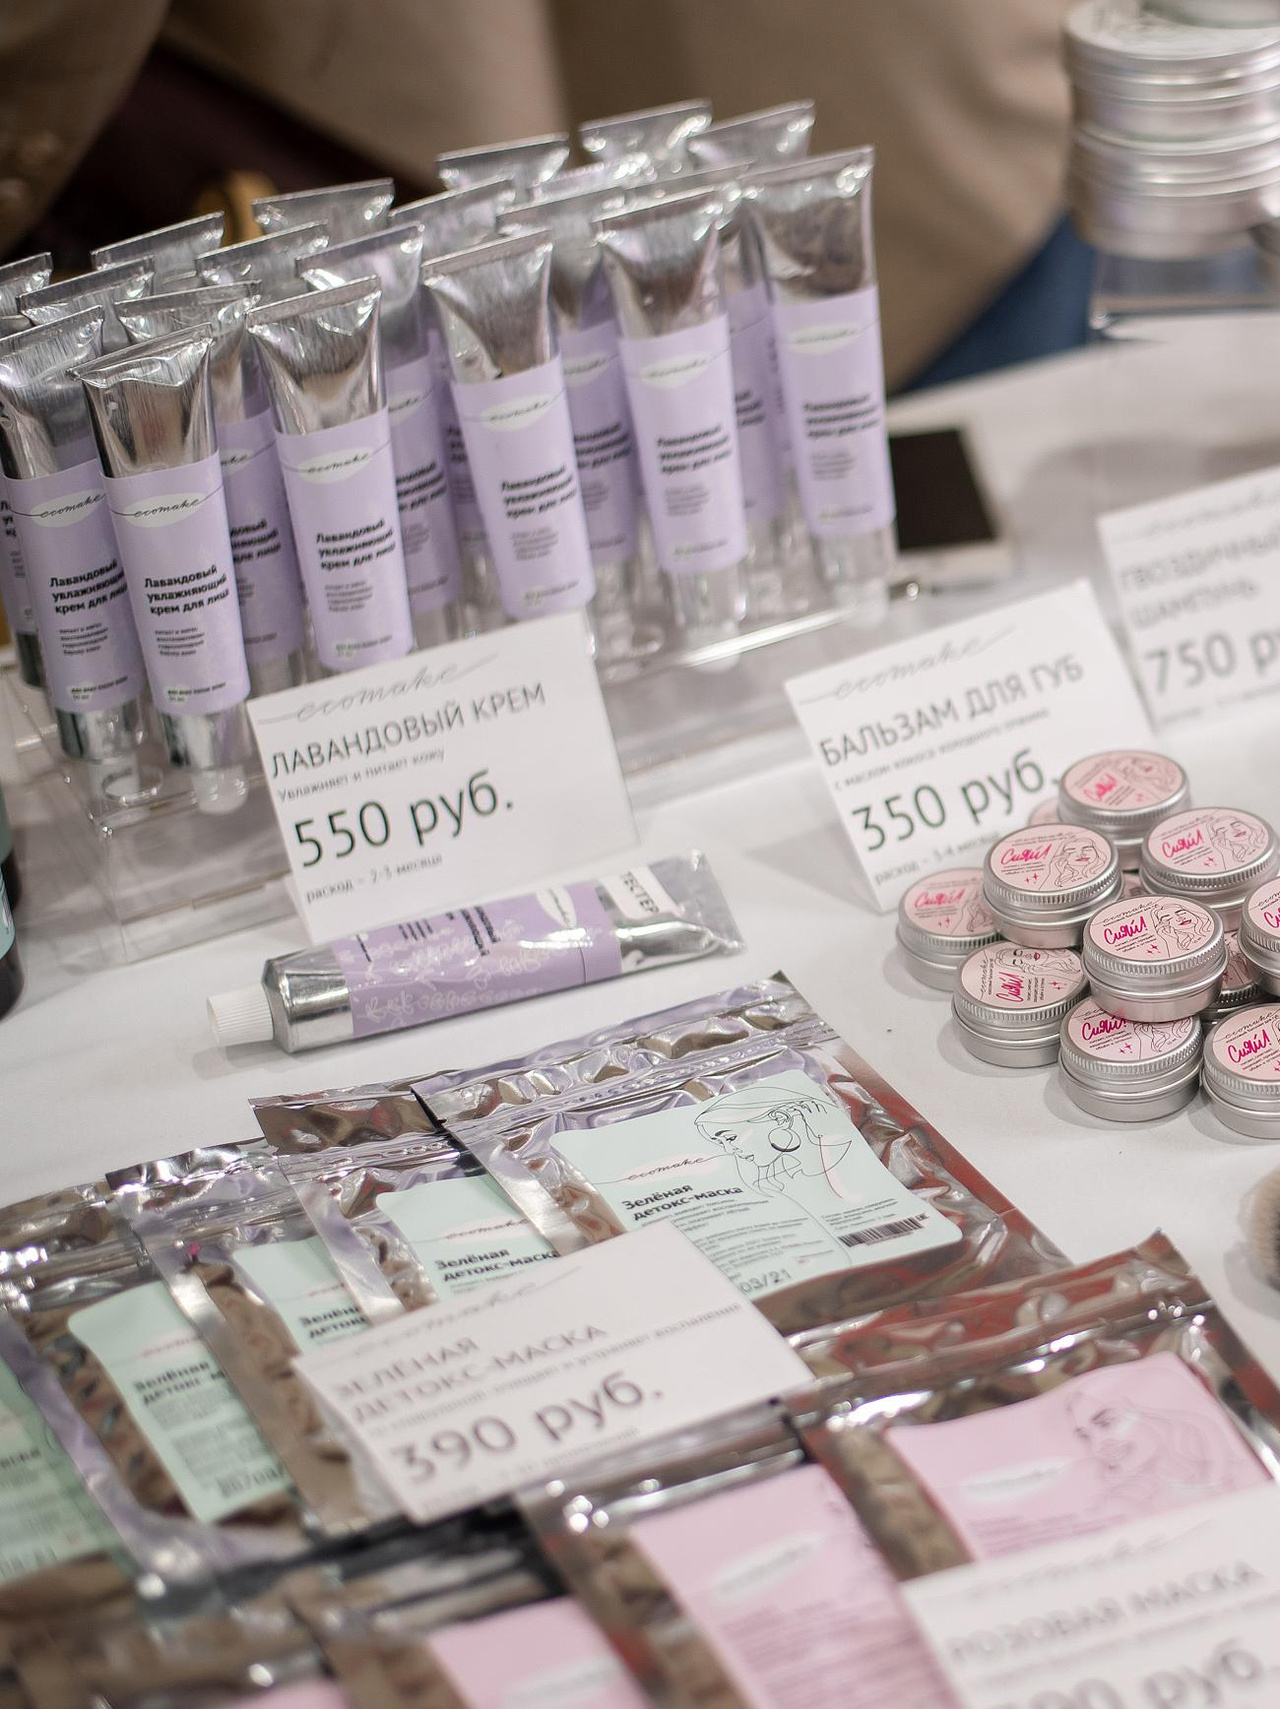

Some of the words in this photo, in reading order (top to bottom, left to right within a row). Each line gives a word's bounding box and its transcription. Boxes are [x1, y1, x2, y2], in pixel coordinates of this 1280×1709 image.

[50, 559, 118, 588] Лавандовый
[144, 565, 219, 590] Лавандовый
[55, 602, 86, 615] крем
[88, 594, 108, 610] для
[149, 603, 181, 617] крем
[182, 598, 206, 614] для
[206, 588, 230, 606] лица
[1143, 631, 1238, 696] 750
[278, 660, 477, 724] ecomake
[820, 698, 959, 768] БАЛЬЗАМ
[965, 679, 1028, 721] ДЛЯ
[1029, 653, 1086, 695] ГУБ
[271, 705, 467, 779] ЛАВАНДОВЫЙ
[471, 682, 548, 723] КРЕМ
[412, 746, 446, 770] кожу
[852, 784, 947, 852] 350
[961, 749, 1061, 826] руб.
[294, 799, 391, 868] 550
[410, 768, 515, 847] руб.
[306, 879, 355, 904] расход
[626, 1156, 708, 1181] ecomake
[621, 1184, 694, 1210] Зелёная
[633, 1186, 744, 1221] детокс-маска
[435, 1248, 511, 1270] Зелёная
[739, 1268, 792, 1293] 03/21
[353, 1324, 608, 1426] ДЕТОКС-МАСКА
[391, 1415, 517, 1485] 390
[535, 1370, 665, 1443] руб.
[945, 1596, 1127, 1664] РОЗОВАЯ
[1127, 1559, 1268, 1616] МАСКА
